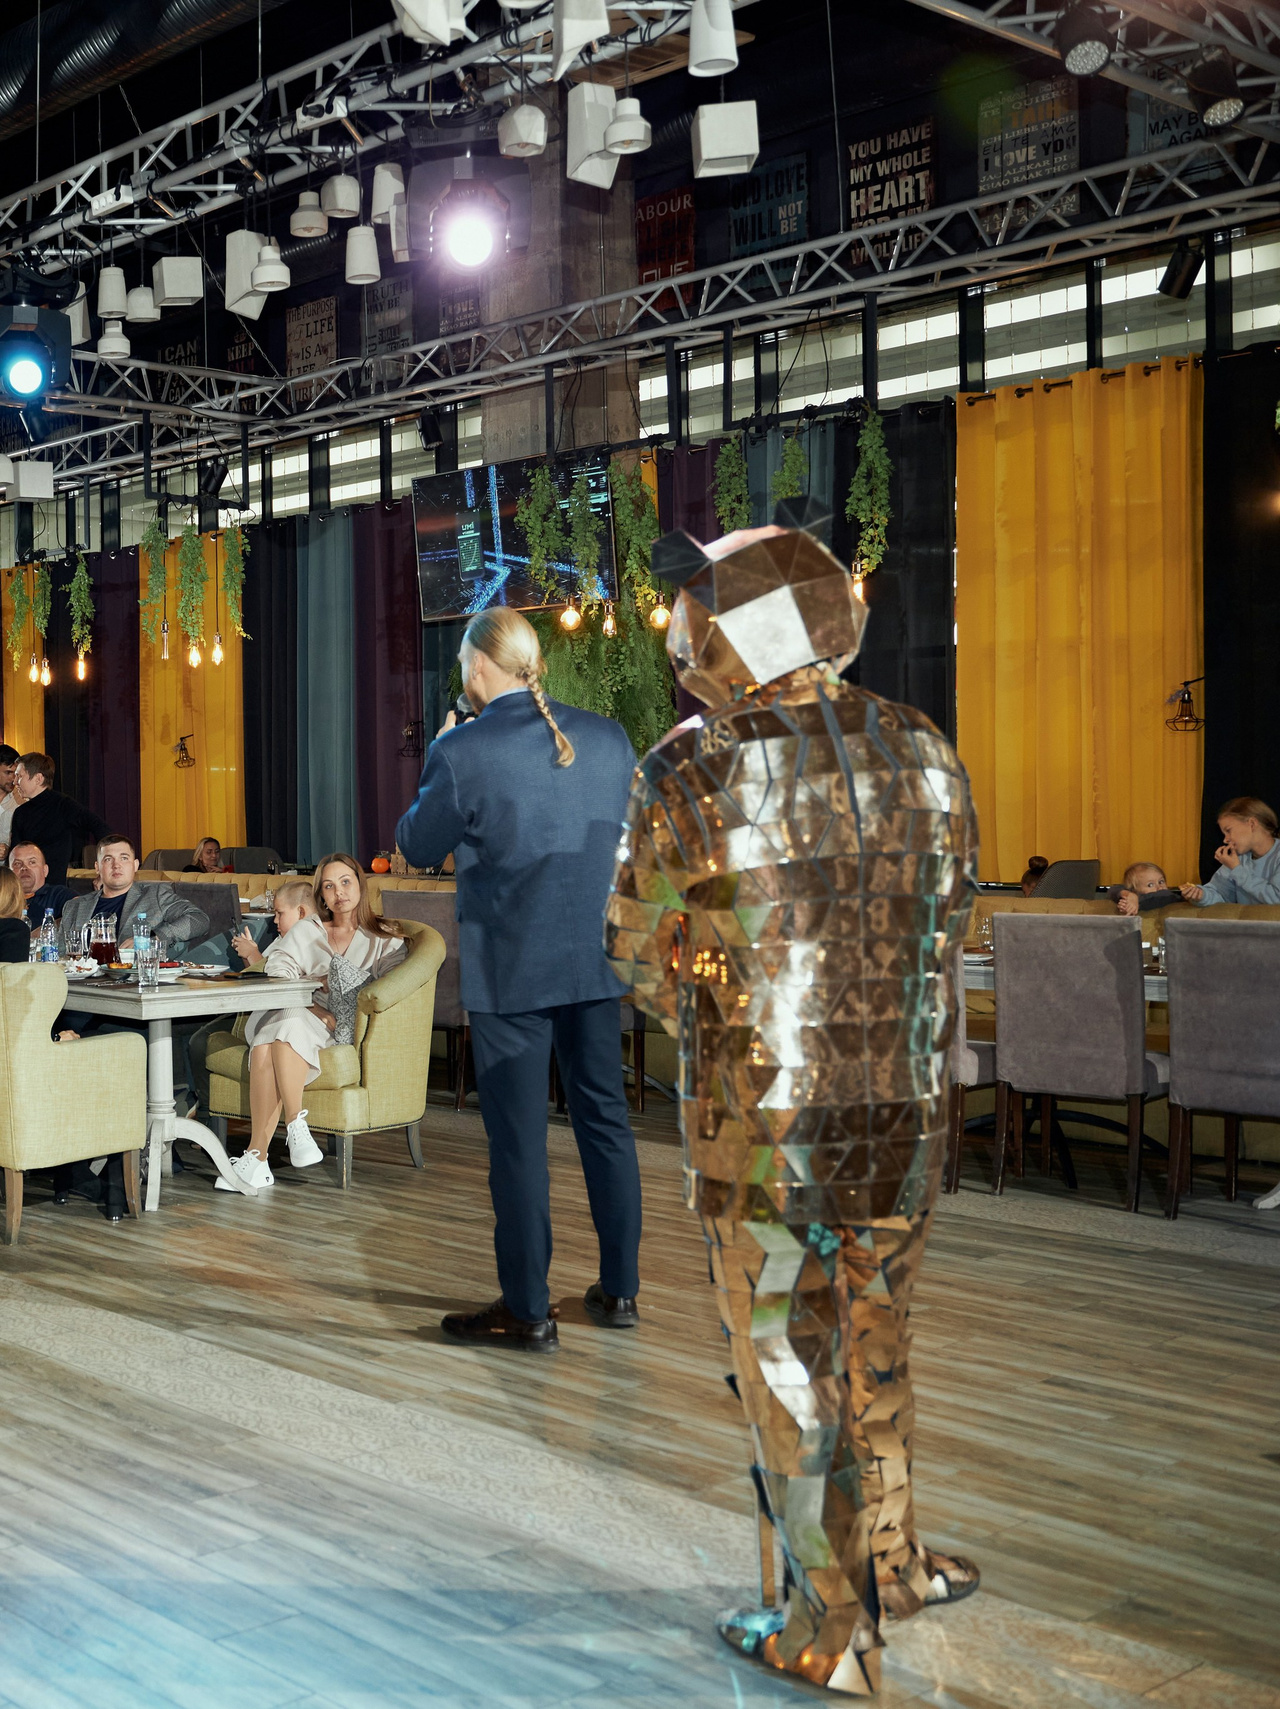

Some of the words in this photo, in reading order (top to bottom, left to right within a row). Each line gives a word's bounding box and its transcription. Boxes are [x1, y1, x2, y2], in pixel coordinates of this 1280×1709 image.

[982, 134, 1001, 146] ICH
[1005, 125, 1038, 139] LIEBE
[1149, 114, 1183, 136] MAY
[1188, 112, 1199, 126] B
[848, 137, 881, 160] YOU
[886, 122, 932, 150] HAVE
[984, 158, 989, 171] I
[994, 145, 1037, 168] LOVE
[1041, 135, 1077, 156] YOU
[850, 163, 873, 185] MY
[876, 146, 932, 177] WHOLE
[1004, 159, 1051, 177] ALSKAR
[766, 163, 806, 200] LOVE
[979, 179, 1010, 192] KHAO
[1013, 170, 1044, 184] RAAK
[850, 169, 930, 218] HEART
[732, 208, 777, 247] WILL
[778, 200, 803, 220] NOT
[780, 217, 798, 236] BE
[287, 308, 302, 323] THE
[303, 298, 335, 319] PURPOSE
[388, 297, 400, 310] BE
[305, 316, 334, 339] LIFE
[164, 340, 198, 362] CAN
[227, 341, 255, 362] KEEP
[301, 345, 312, 360] IS
[314, 343, 322, 357] A
